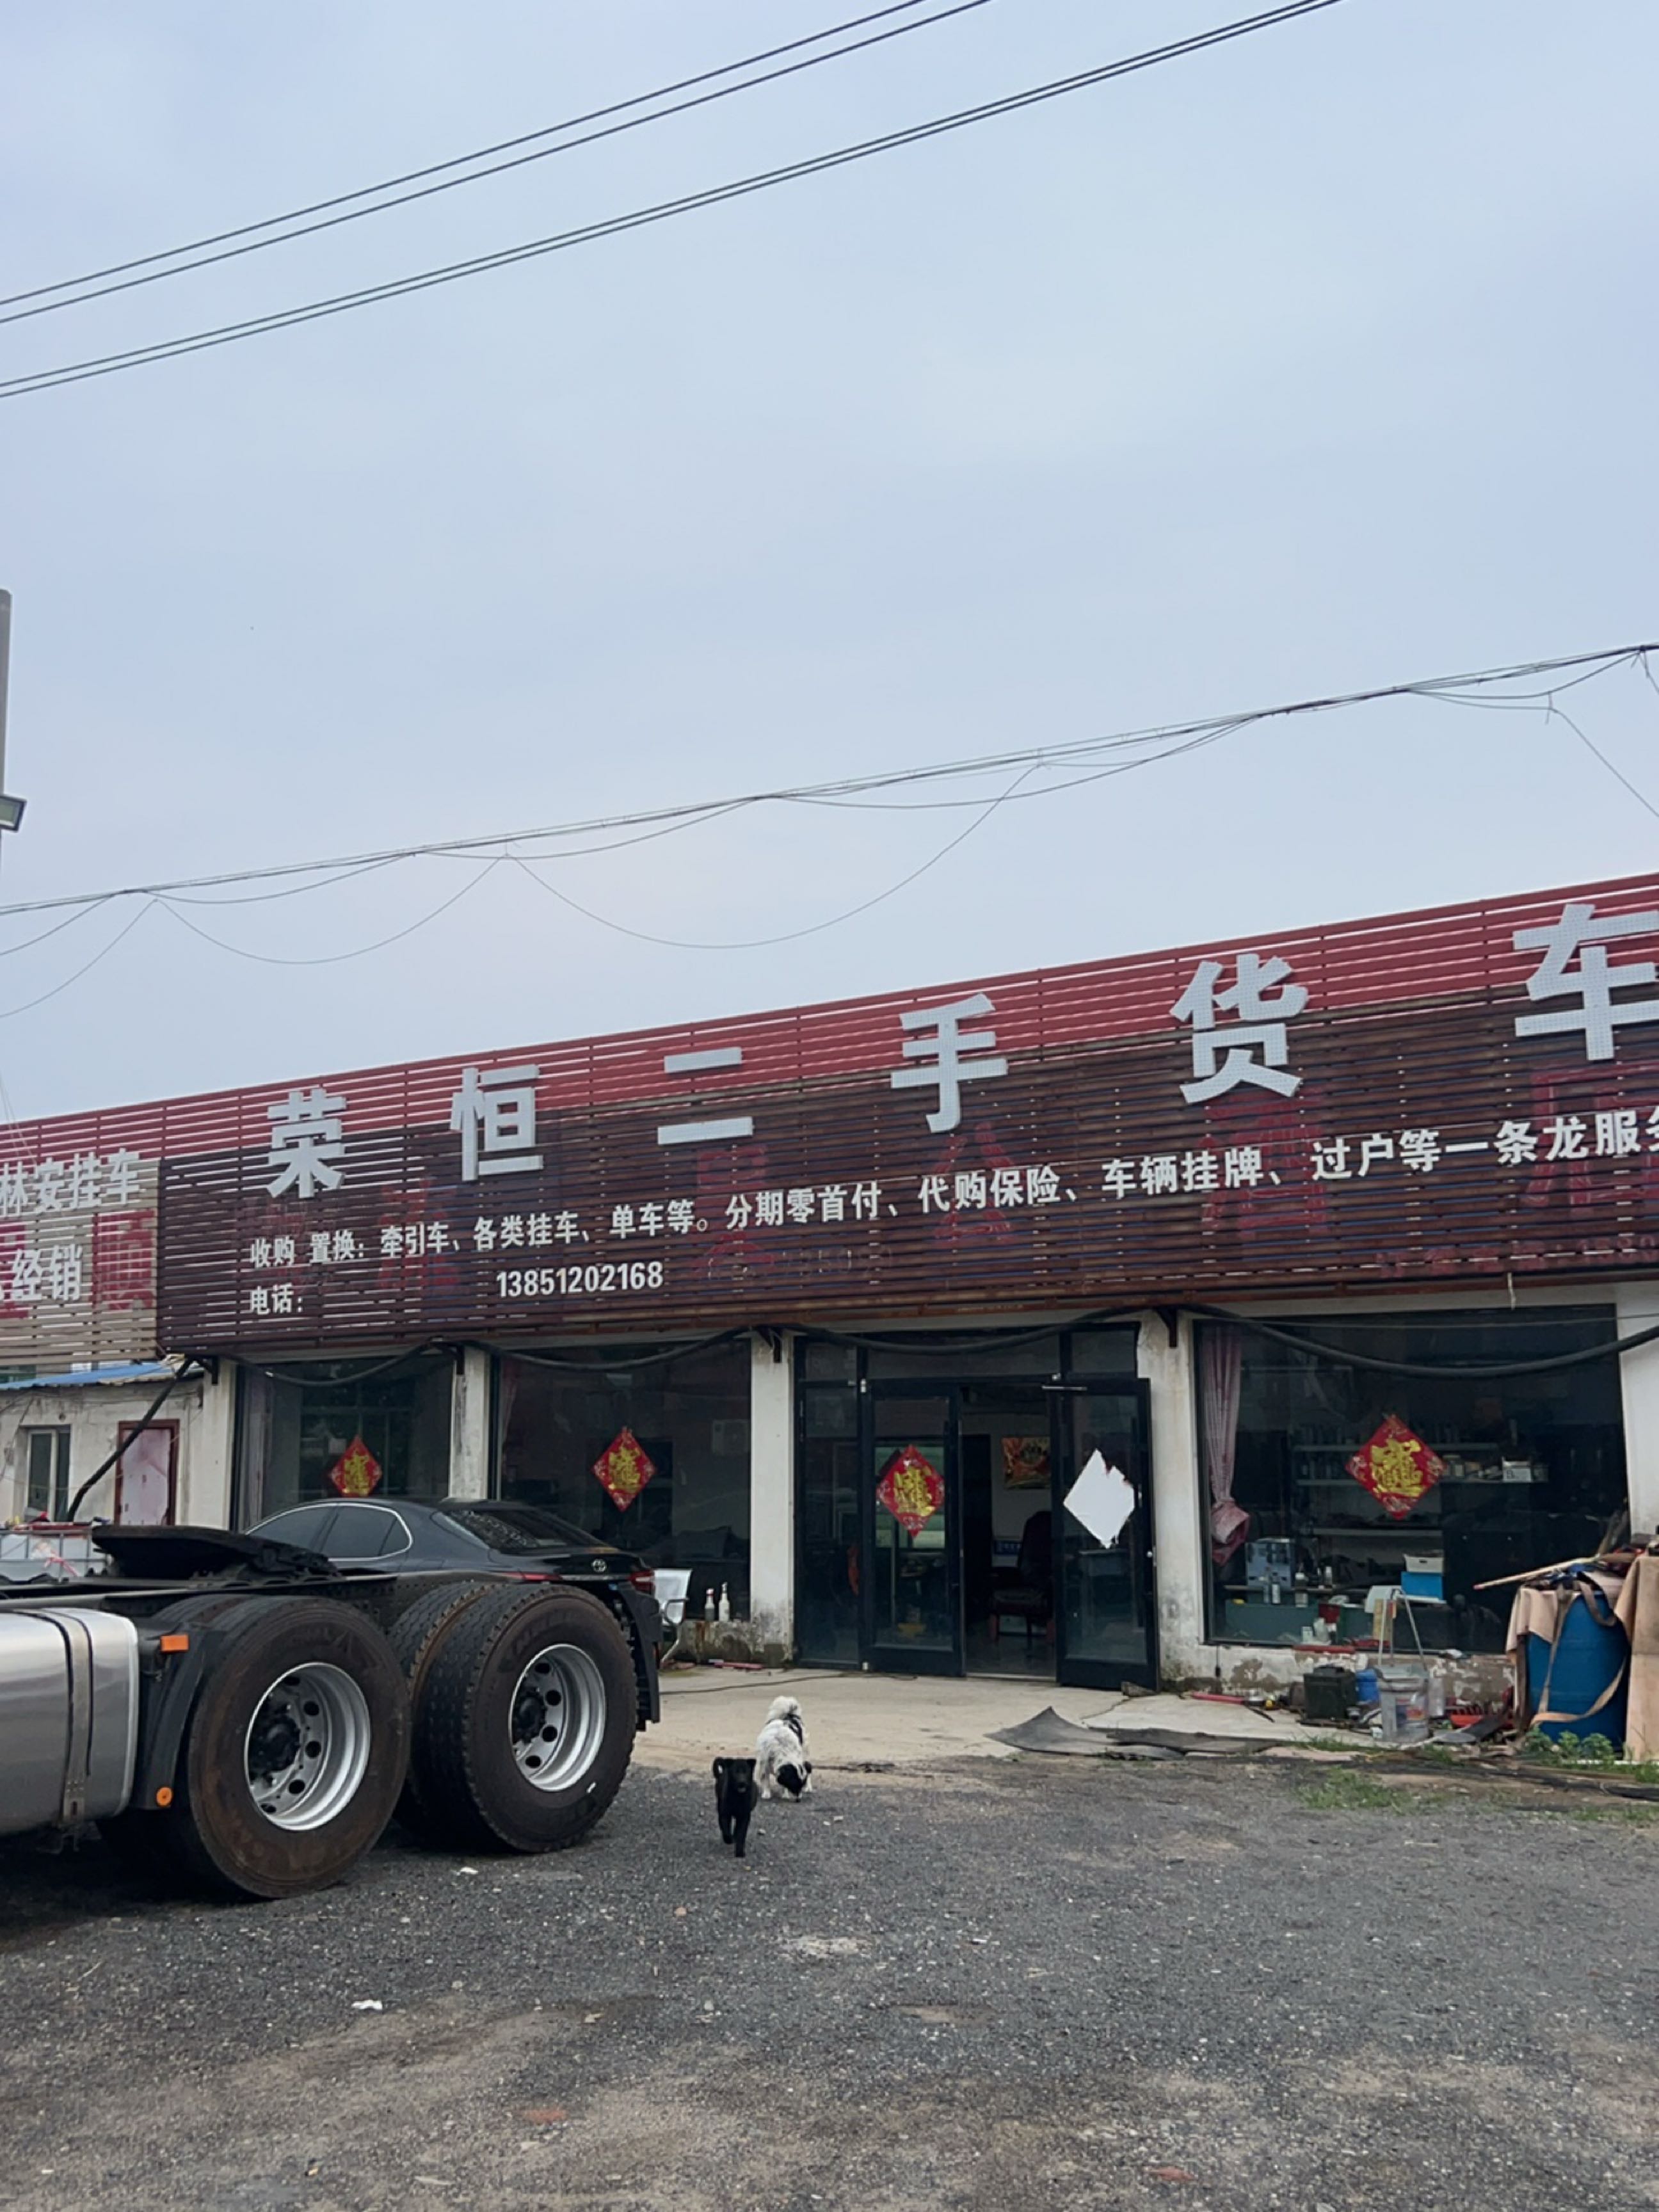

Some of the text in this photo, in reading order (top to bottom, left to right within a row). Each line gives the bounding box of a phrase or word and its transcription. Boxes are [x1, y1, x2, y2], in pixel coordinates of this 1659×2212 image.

[266, 903, 1659, 1198] 荣恒二手货车
[0, 1244, 83, 1301] 经销
[250, 1236, 295, 1268] 收购
[496, 1261, 664, 1297] 13851202168
